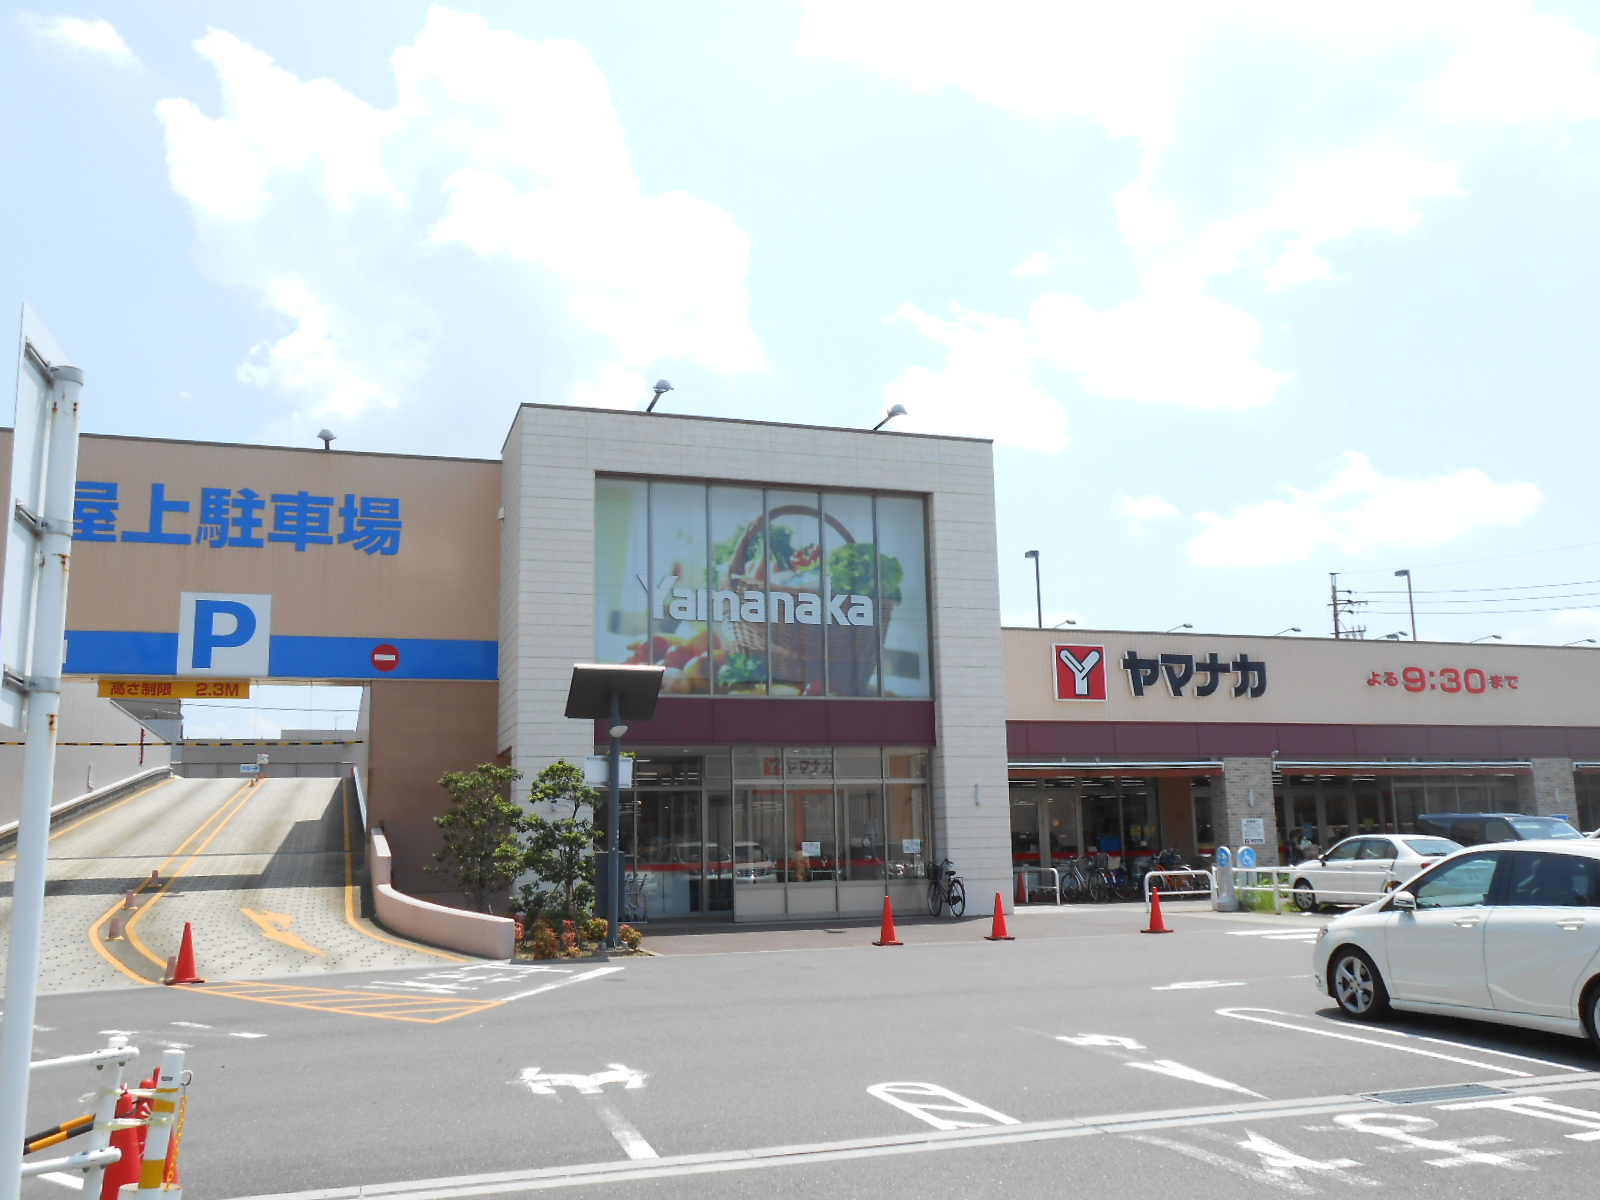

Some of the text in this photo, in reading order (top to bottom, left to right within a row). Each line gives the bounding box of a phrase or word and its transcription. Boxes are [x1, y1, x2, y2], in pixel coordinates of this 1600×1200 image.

[72, 481, 403, 557] 屋上駐車場
[636, 574, 874, 627] Yamanaka
[191, 599, 257, 669] P
[110, 682, 240, 697] 高さ制限 2.3M
[1119, 650, 1267, 698] ヤマナカ
[1366, 666, 1519, 694] よる9:30まで
